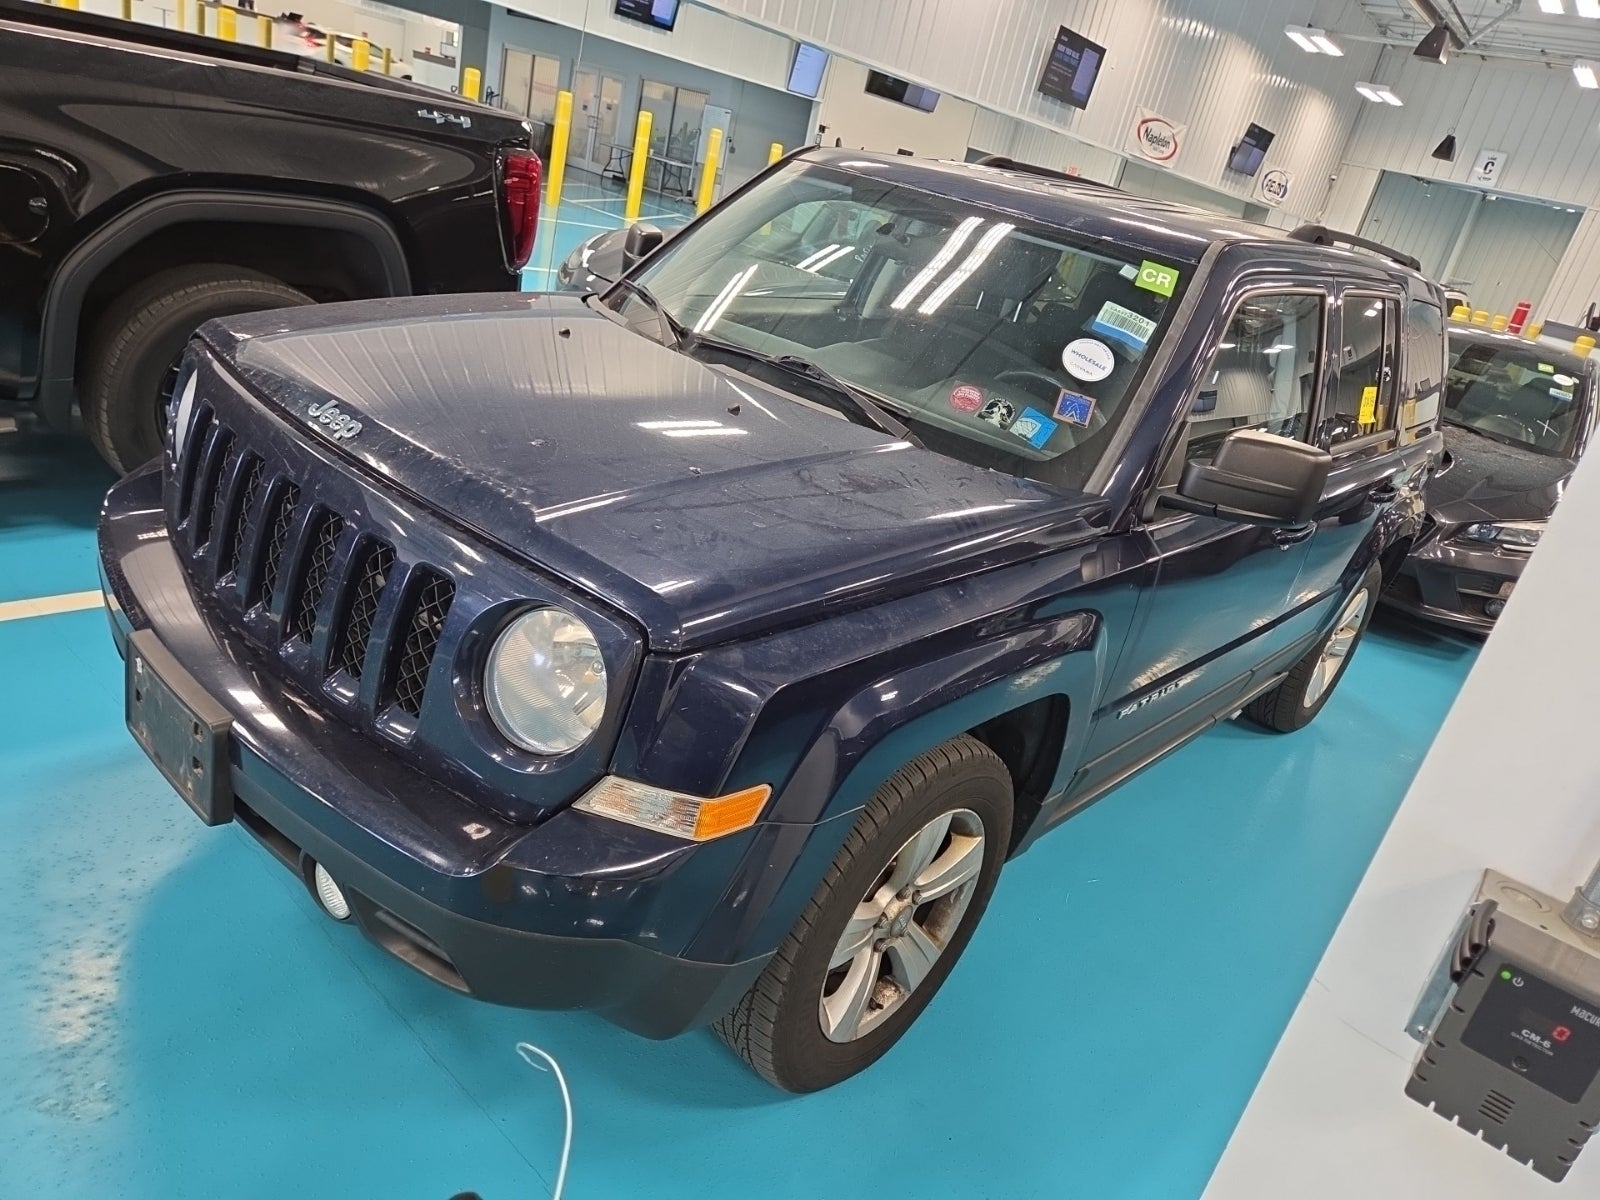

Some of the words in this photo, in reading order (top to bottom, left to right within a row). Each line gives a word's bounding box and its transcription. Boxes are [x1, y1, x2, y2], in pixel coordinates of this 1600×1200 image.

[1143, 126, 1171, 149] Napleton
[1483, 161, 1495, 175] C
[1142, 268, 1172, 288] CR
[1071, 349, 1107, 371] WHOLESALE
[308, 399, 363, 439] Jeep
[1521, 1028, 1552, 1048] CM-6
